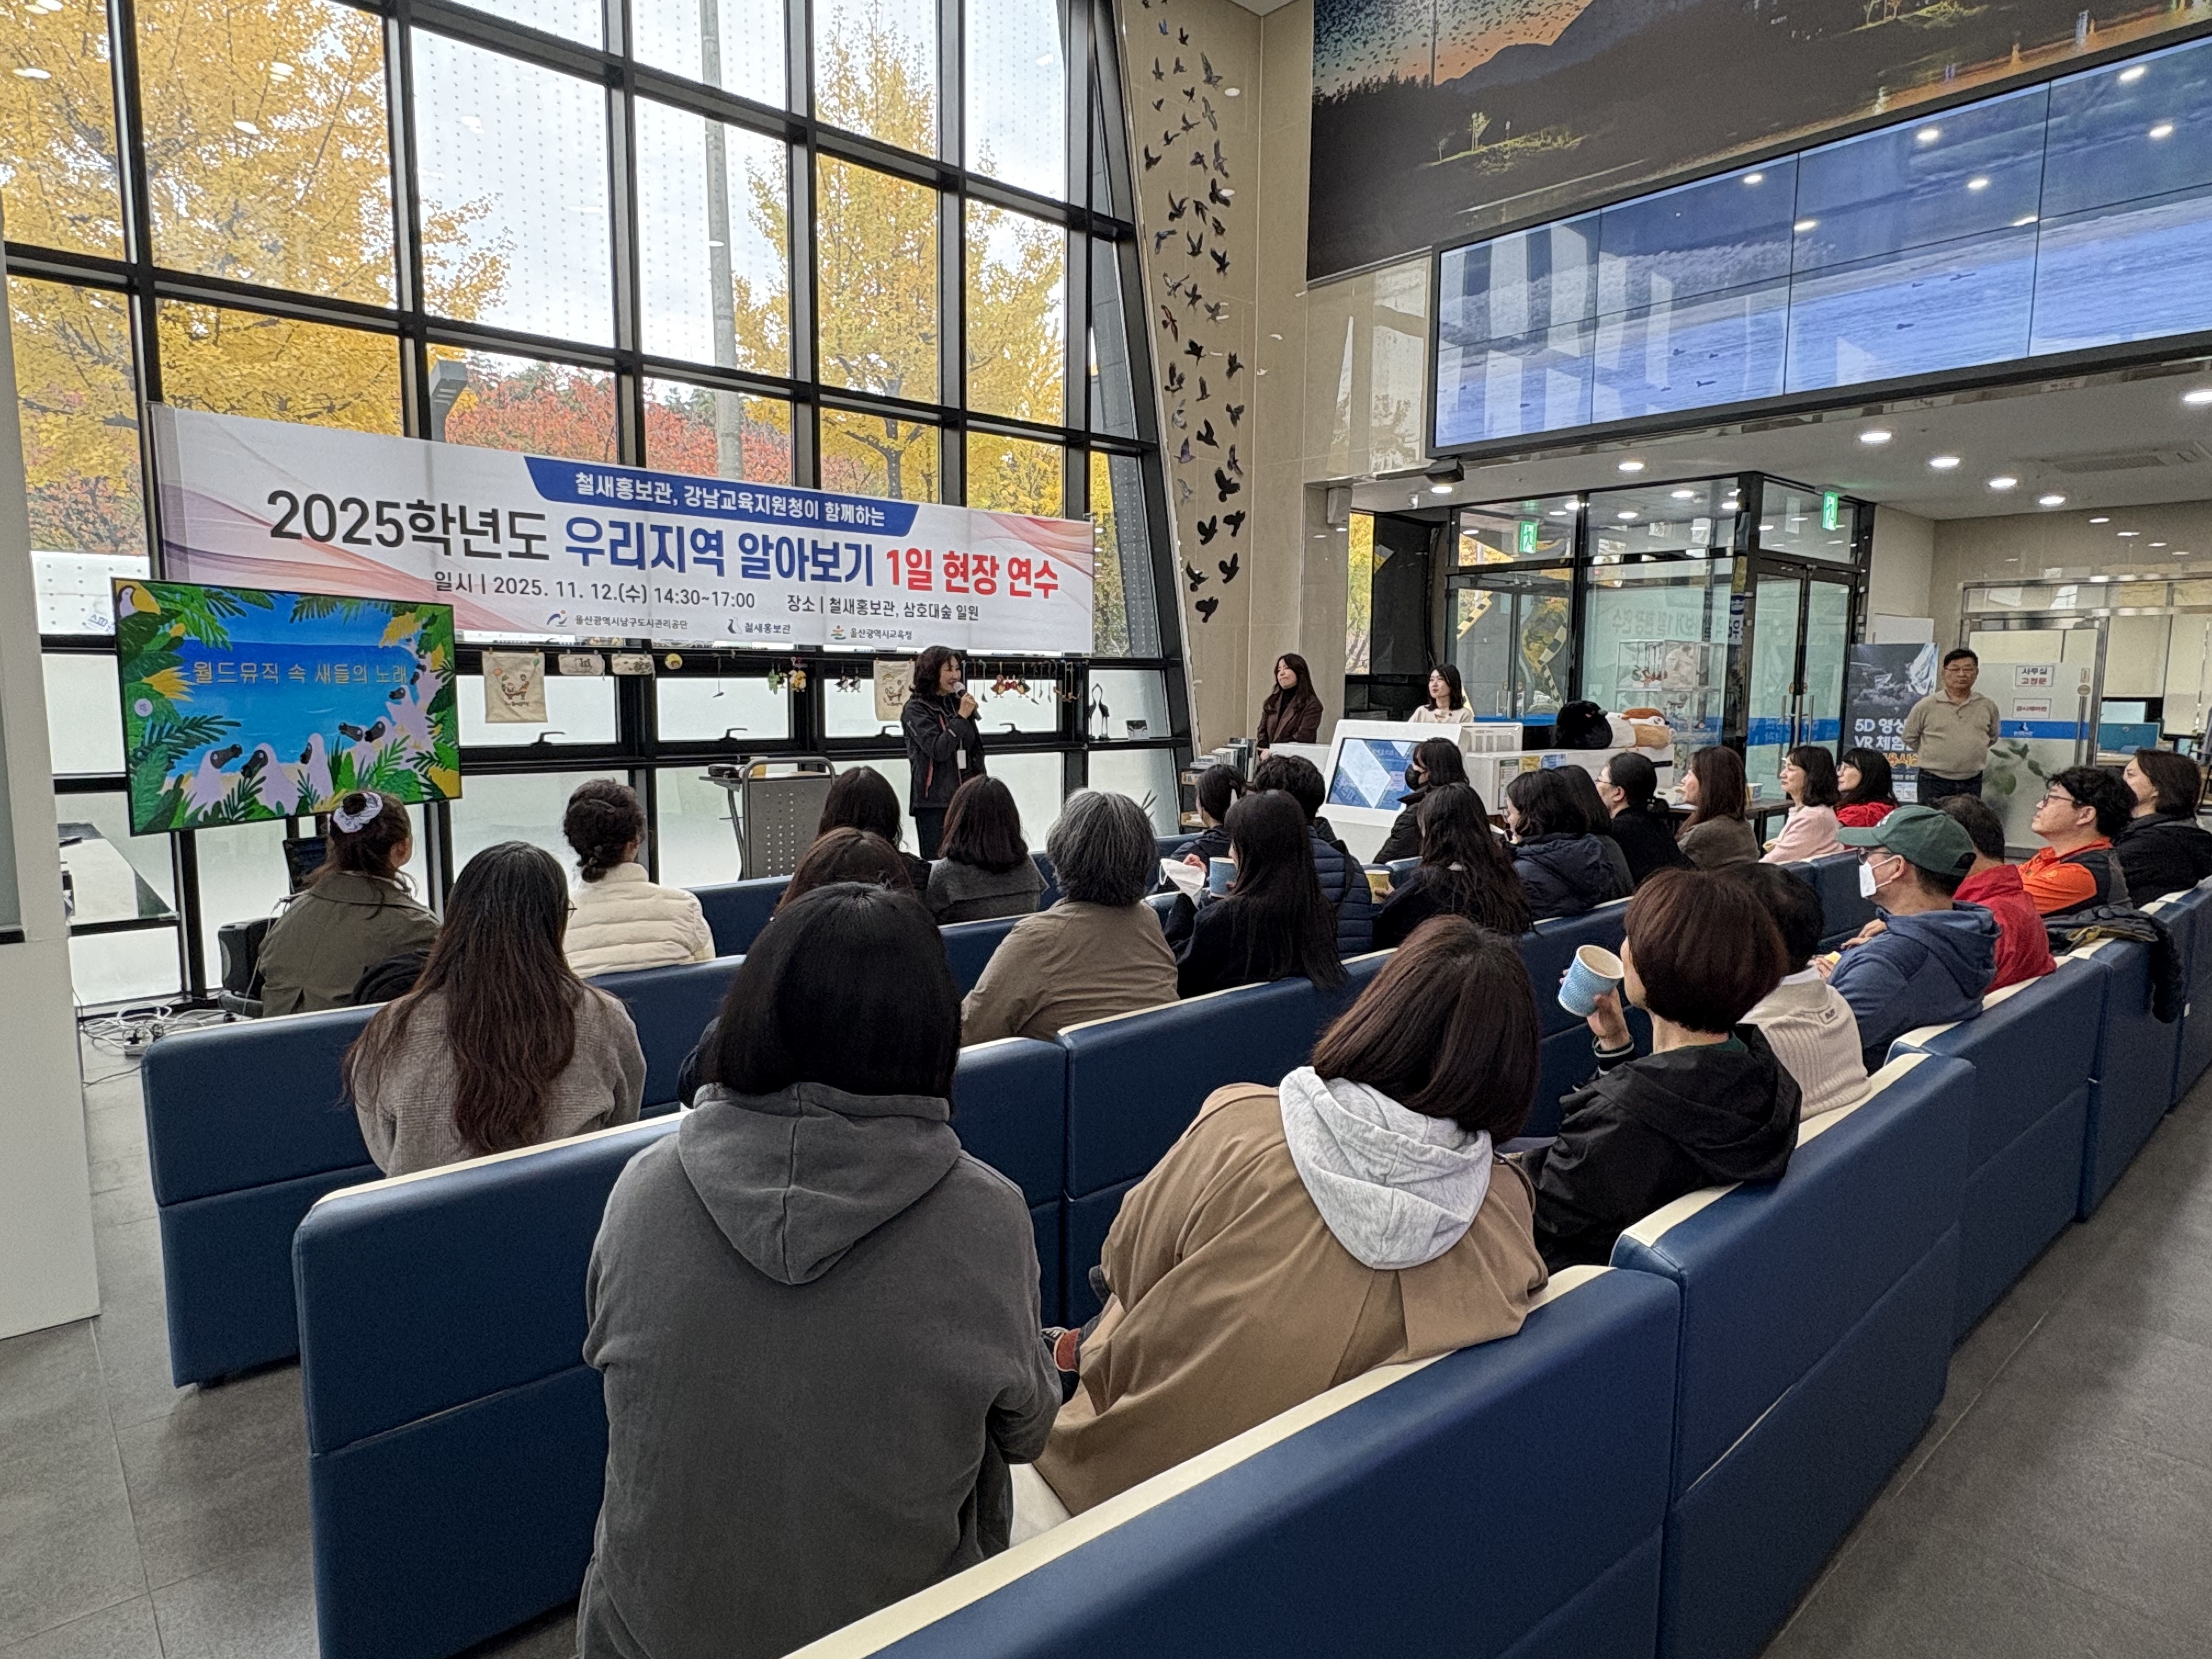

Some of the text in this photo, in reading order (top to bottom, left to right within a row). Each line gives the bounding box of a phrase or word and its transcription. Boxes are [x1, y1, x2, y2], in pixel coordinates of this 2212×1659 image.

[575, 472, 885, 527] 철새홍보관, 강남교육지원청이 함께하는
[268, 490, 1058, 599] 2025학년도 우리지역 알아보기 1일 현장 연수
[435, 571, 755, 608] 일시 2025. 11. 12.(수) 14:30~17:00
[787, 595, 979, 621] 장소 철새홍보관, 삼호대숲 일원
[744, 622, 791, 634] 철새홍보관
[850, 628, 912, 640] 울산광역시교육청
[193, 662, 408, 685] 월드뮤직 속 새들의 노래
[1854, 719, 1875, 732] 5D
[1854, 736, 1874, 749] VR
